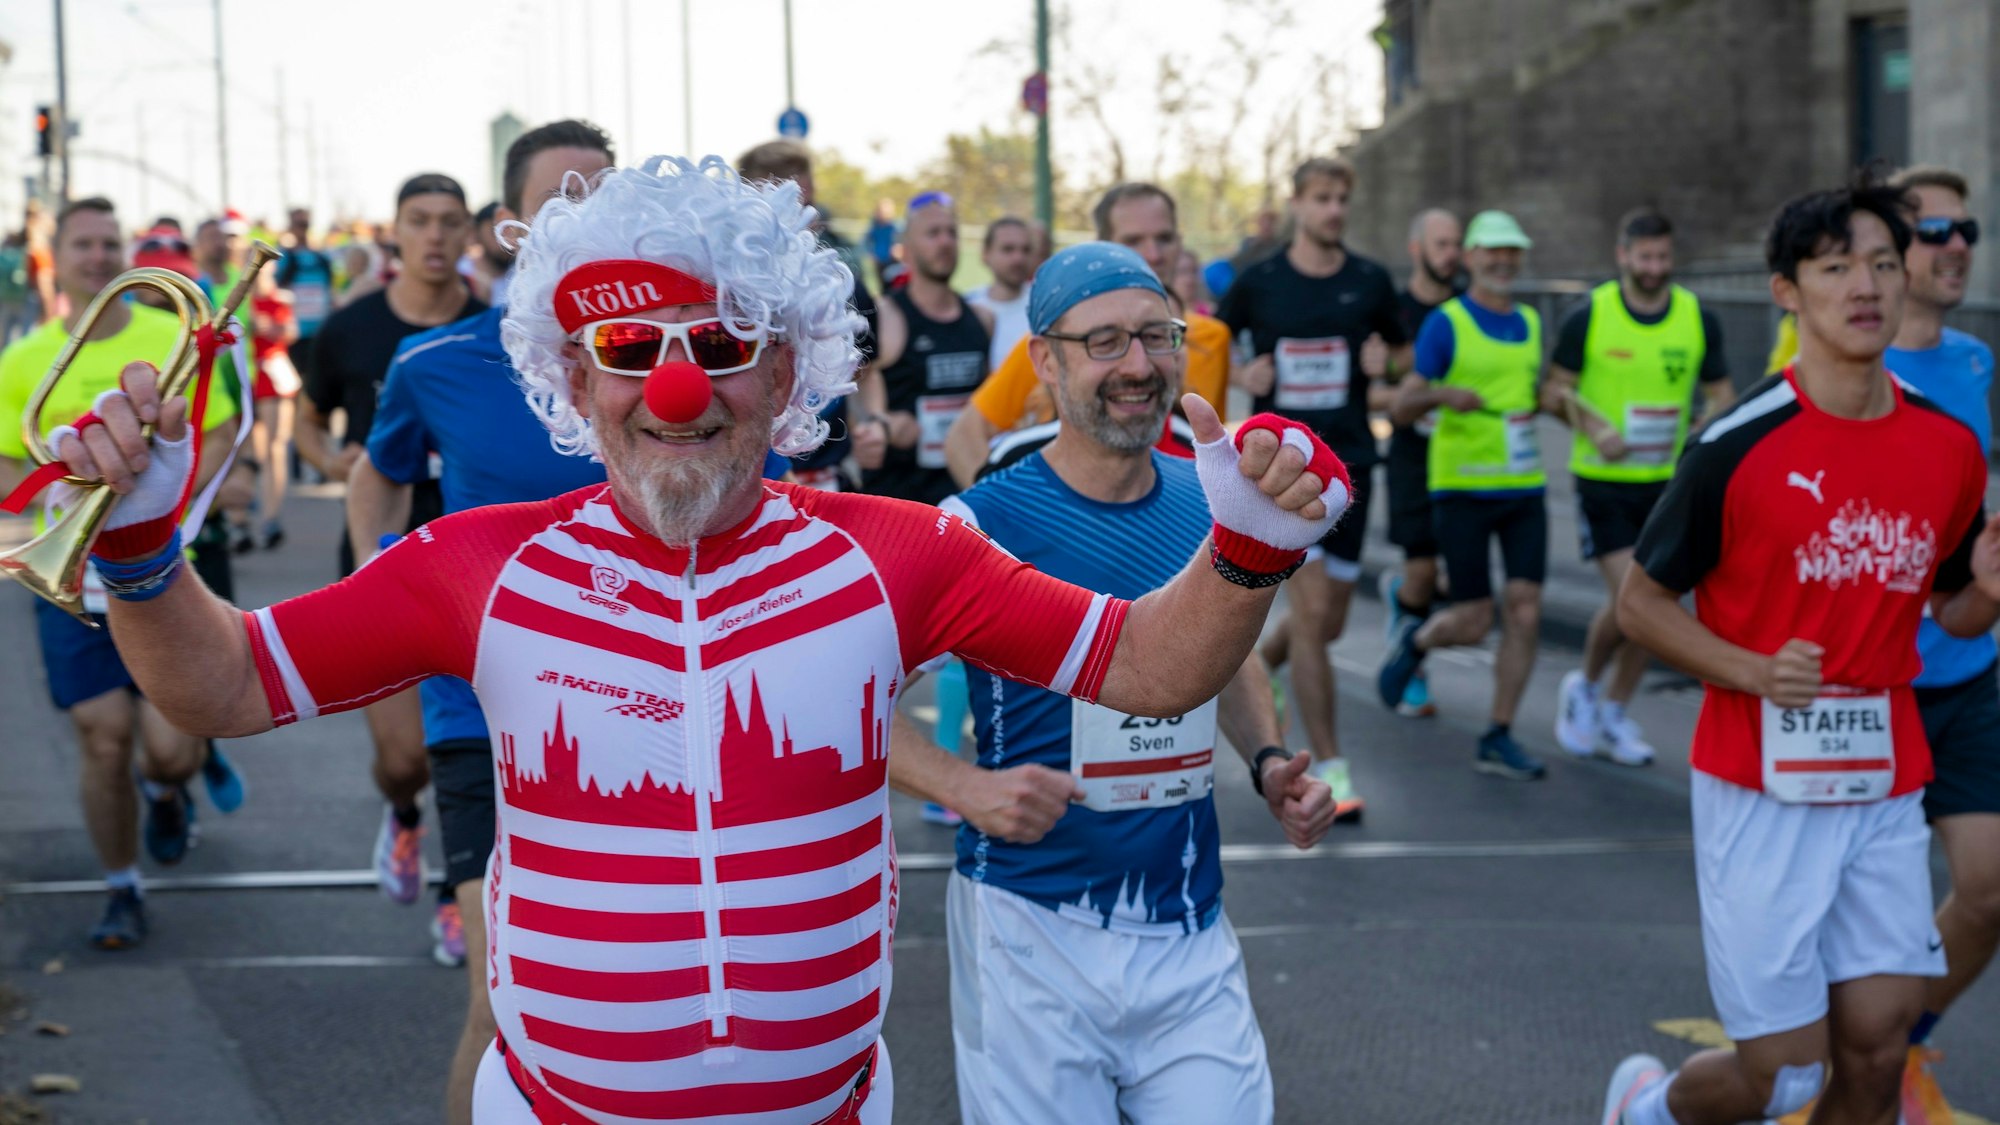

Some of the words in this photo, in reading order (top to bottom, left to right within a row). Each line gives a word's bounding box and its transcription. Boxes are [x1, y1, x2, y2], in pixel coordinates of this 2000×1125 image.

[567, 280, 663, 317] Köln
[1828, 515, 1911, 553] SCHUL
[579, 591, 629, 613] VERGE
[717, 607, 755, 631] Josef
[757, 588, 803, 614] Riefert
[536, 670, 559, 684] JR
[562, 674, 629, 699] RACING
[634, 690, 685, 713] TEAM
[1780, 708, 1884, 733] STAFFEL
[1129, 735, 1174, 752] Sven
[1820, 736, 1850, 753] S34
